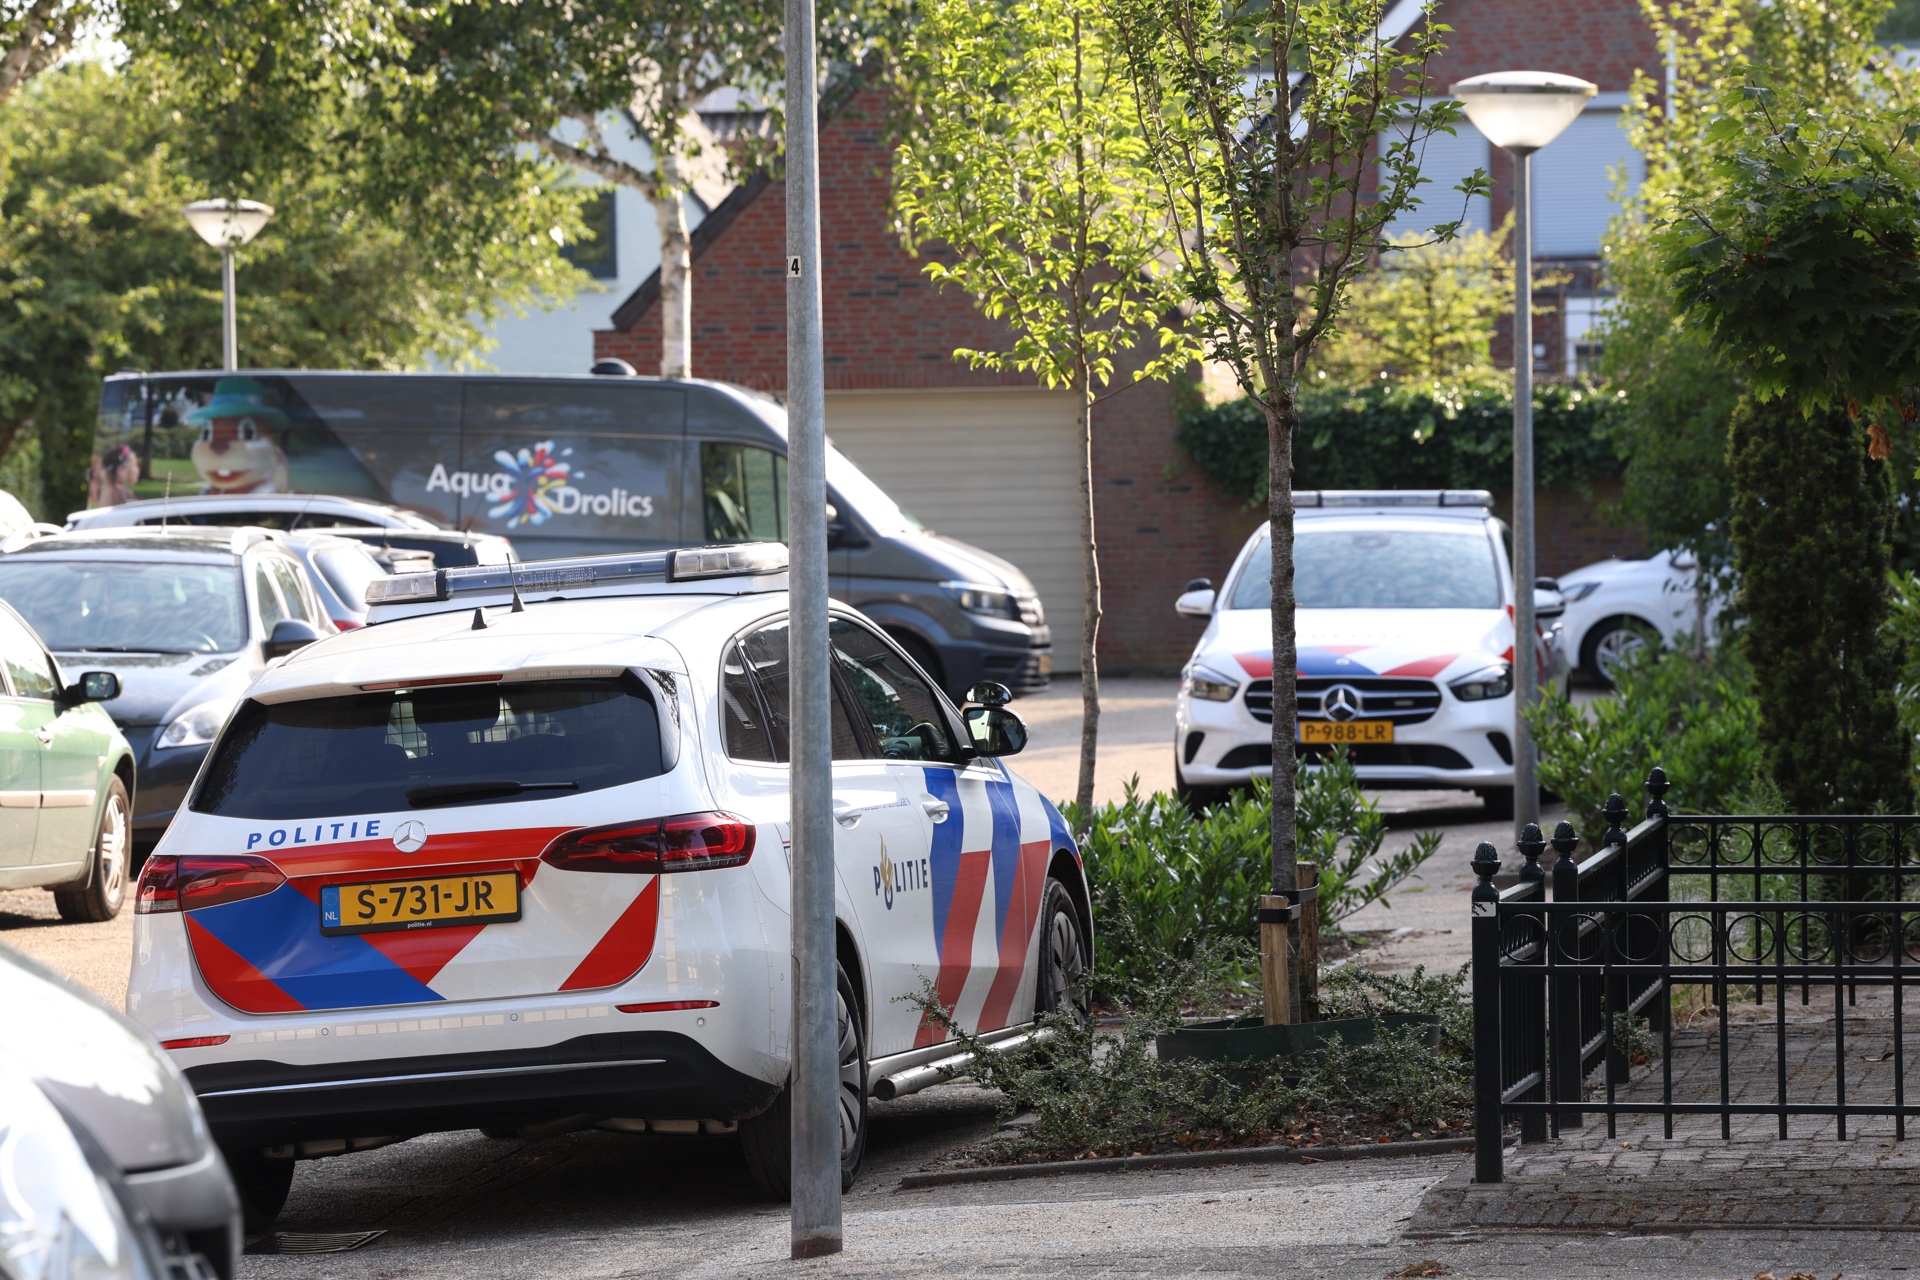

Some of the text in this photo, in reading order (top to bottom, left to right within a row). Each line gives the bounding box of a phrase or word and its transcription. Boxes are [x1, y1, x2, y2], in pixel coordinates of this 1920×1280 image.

[426, 463, 654, 517] Aqua Drolics
[1305, 724, 1386, 740] P-988-LR
[247, 819, 382, 849] POLITIE
[873, 858, 928, 910] POLITIE
[357, 880, 495, 919] S-731-JR
[325, 911, 338, 921] NL
[407, 921, 433, 929] politie.nl
